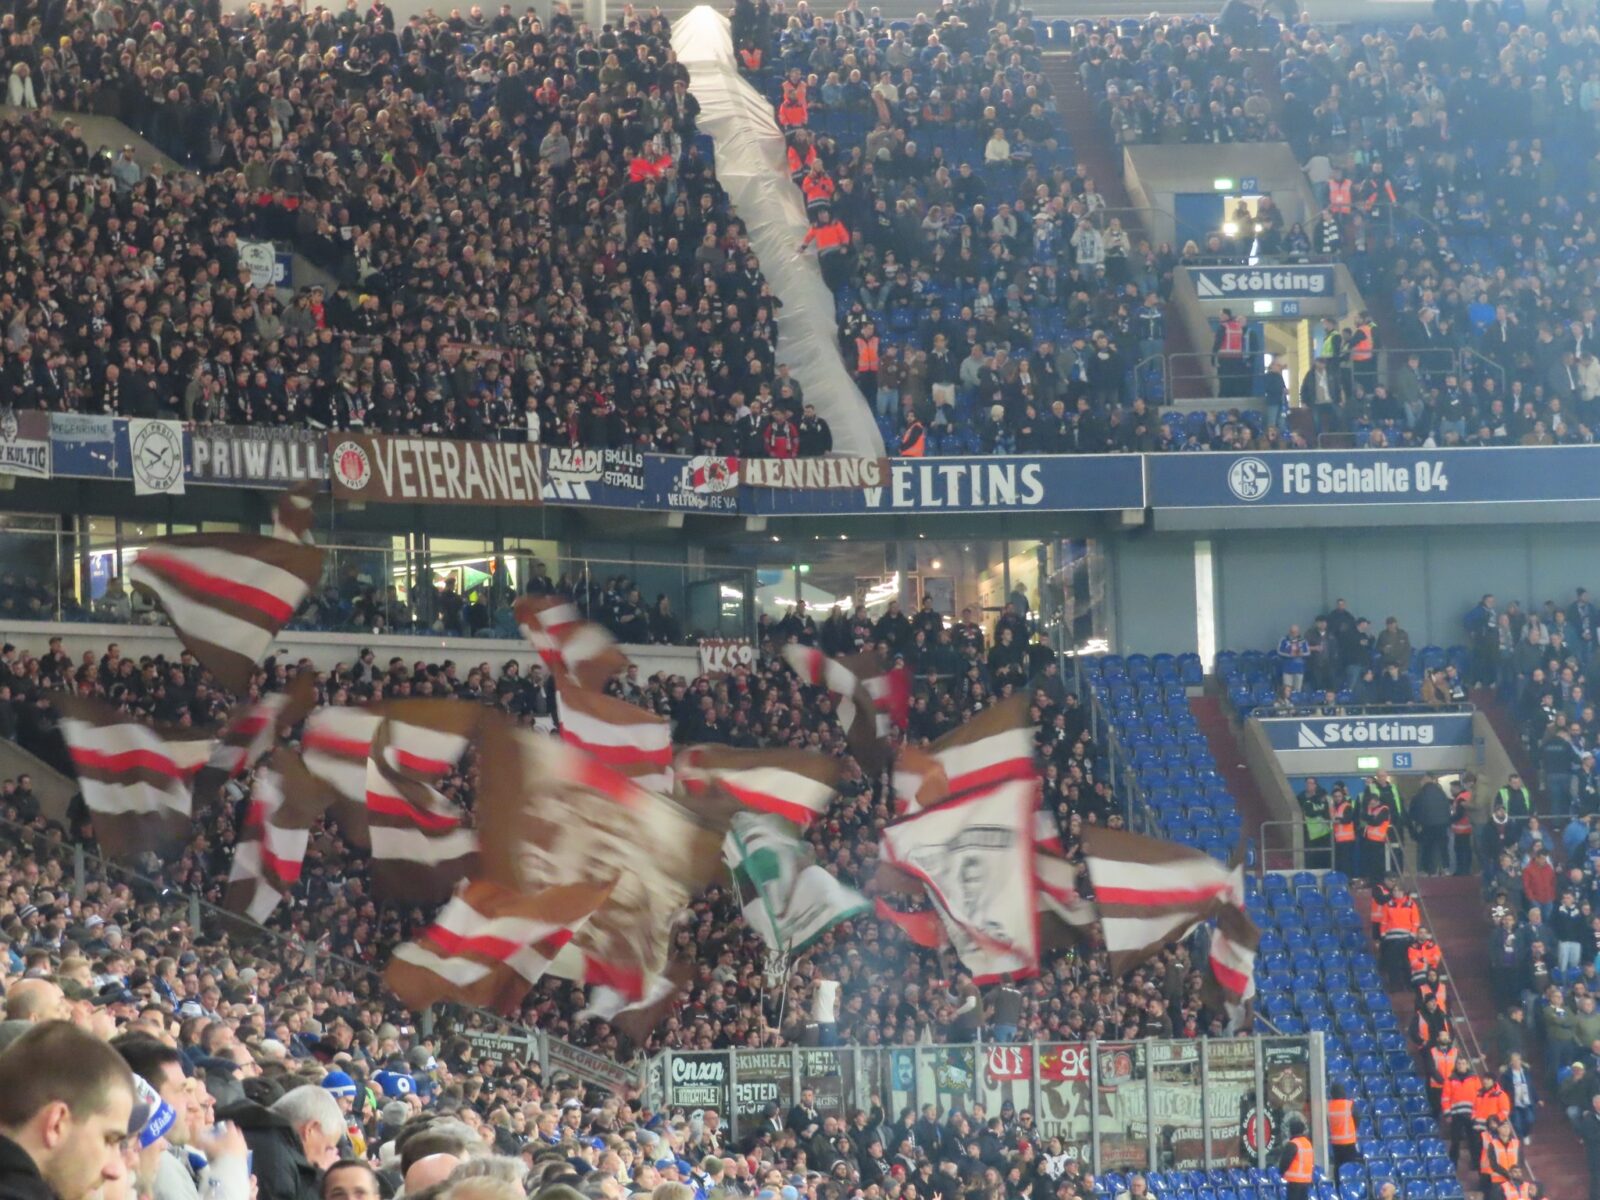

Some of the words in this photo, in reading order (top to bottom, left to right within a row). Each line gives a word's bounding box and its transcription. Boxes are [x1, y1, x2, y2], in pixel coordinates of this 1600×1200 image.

[1242, 179, 1255, 190] 67
[1221, 272, 1324, 292] Stölting
[1284, 304, 1297, 314] 68
[7, 446, 46, 469] KULTIG
[192, 437, 325, 480] PRIWALL
[605, 449, 643, 468] SKULLS
[371, 438, 543, 501] VETERANEN
[746, 457, 871, 488] HENNING
[1283, 463, 1311, 493] FC
[1317, 462, 1409, 493] Schalke
[1415, 461, 1448, 492] 04
[1323, 722, 1434, 744] Stölting
[734, 1053, 803, 1070] SKINHEAS
